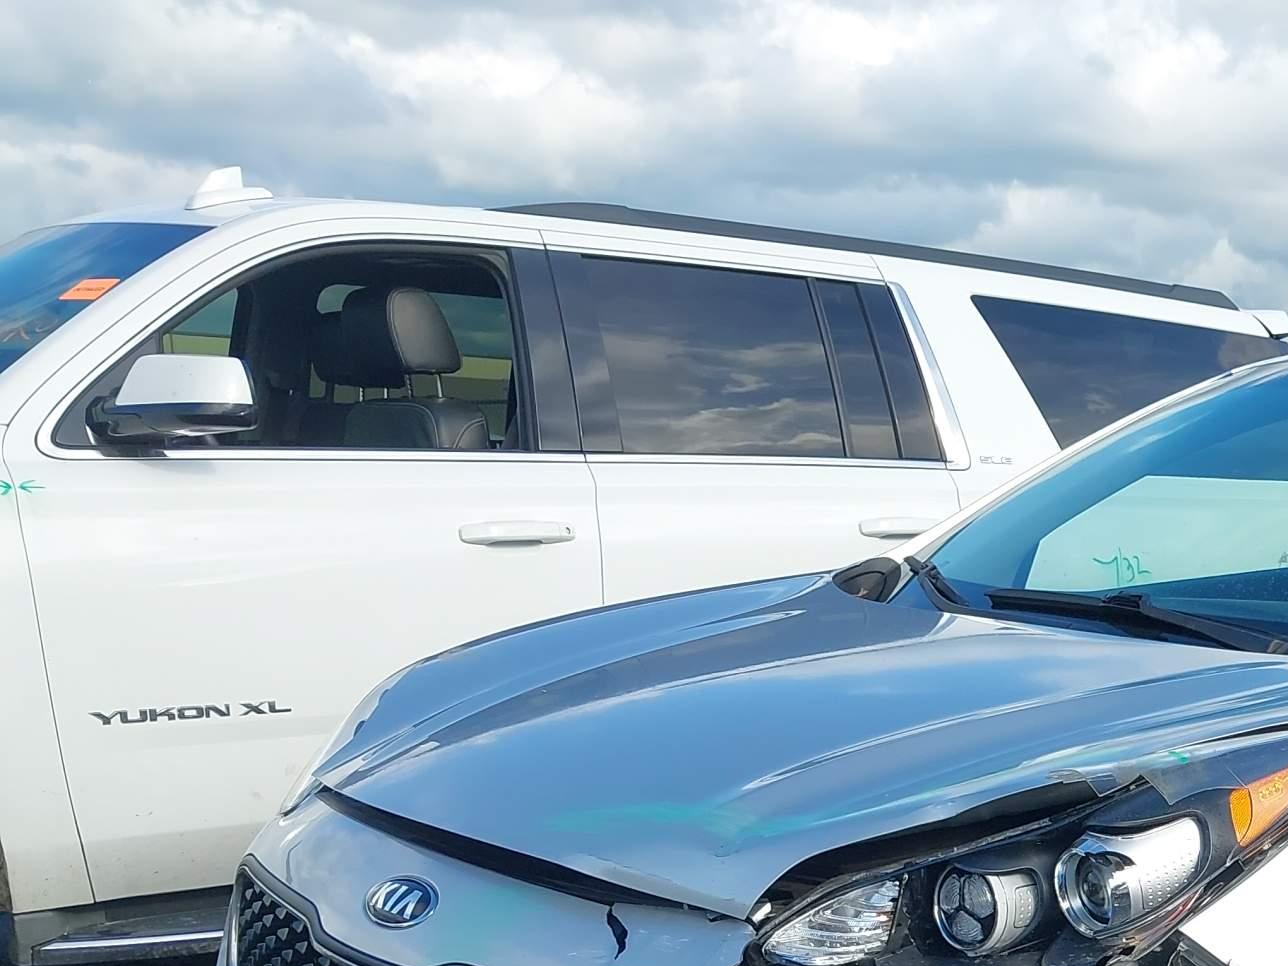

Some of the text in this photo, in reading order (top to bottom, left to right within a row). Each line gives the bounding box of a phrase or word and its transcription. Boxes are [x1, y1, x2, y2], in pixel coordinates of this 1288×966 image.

[88, 700, 292, 726] YUKON XL
[369, 881, 423, 920] KIA
